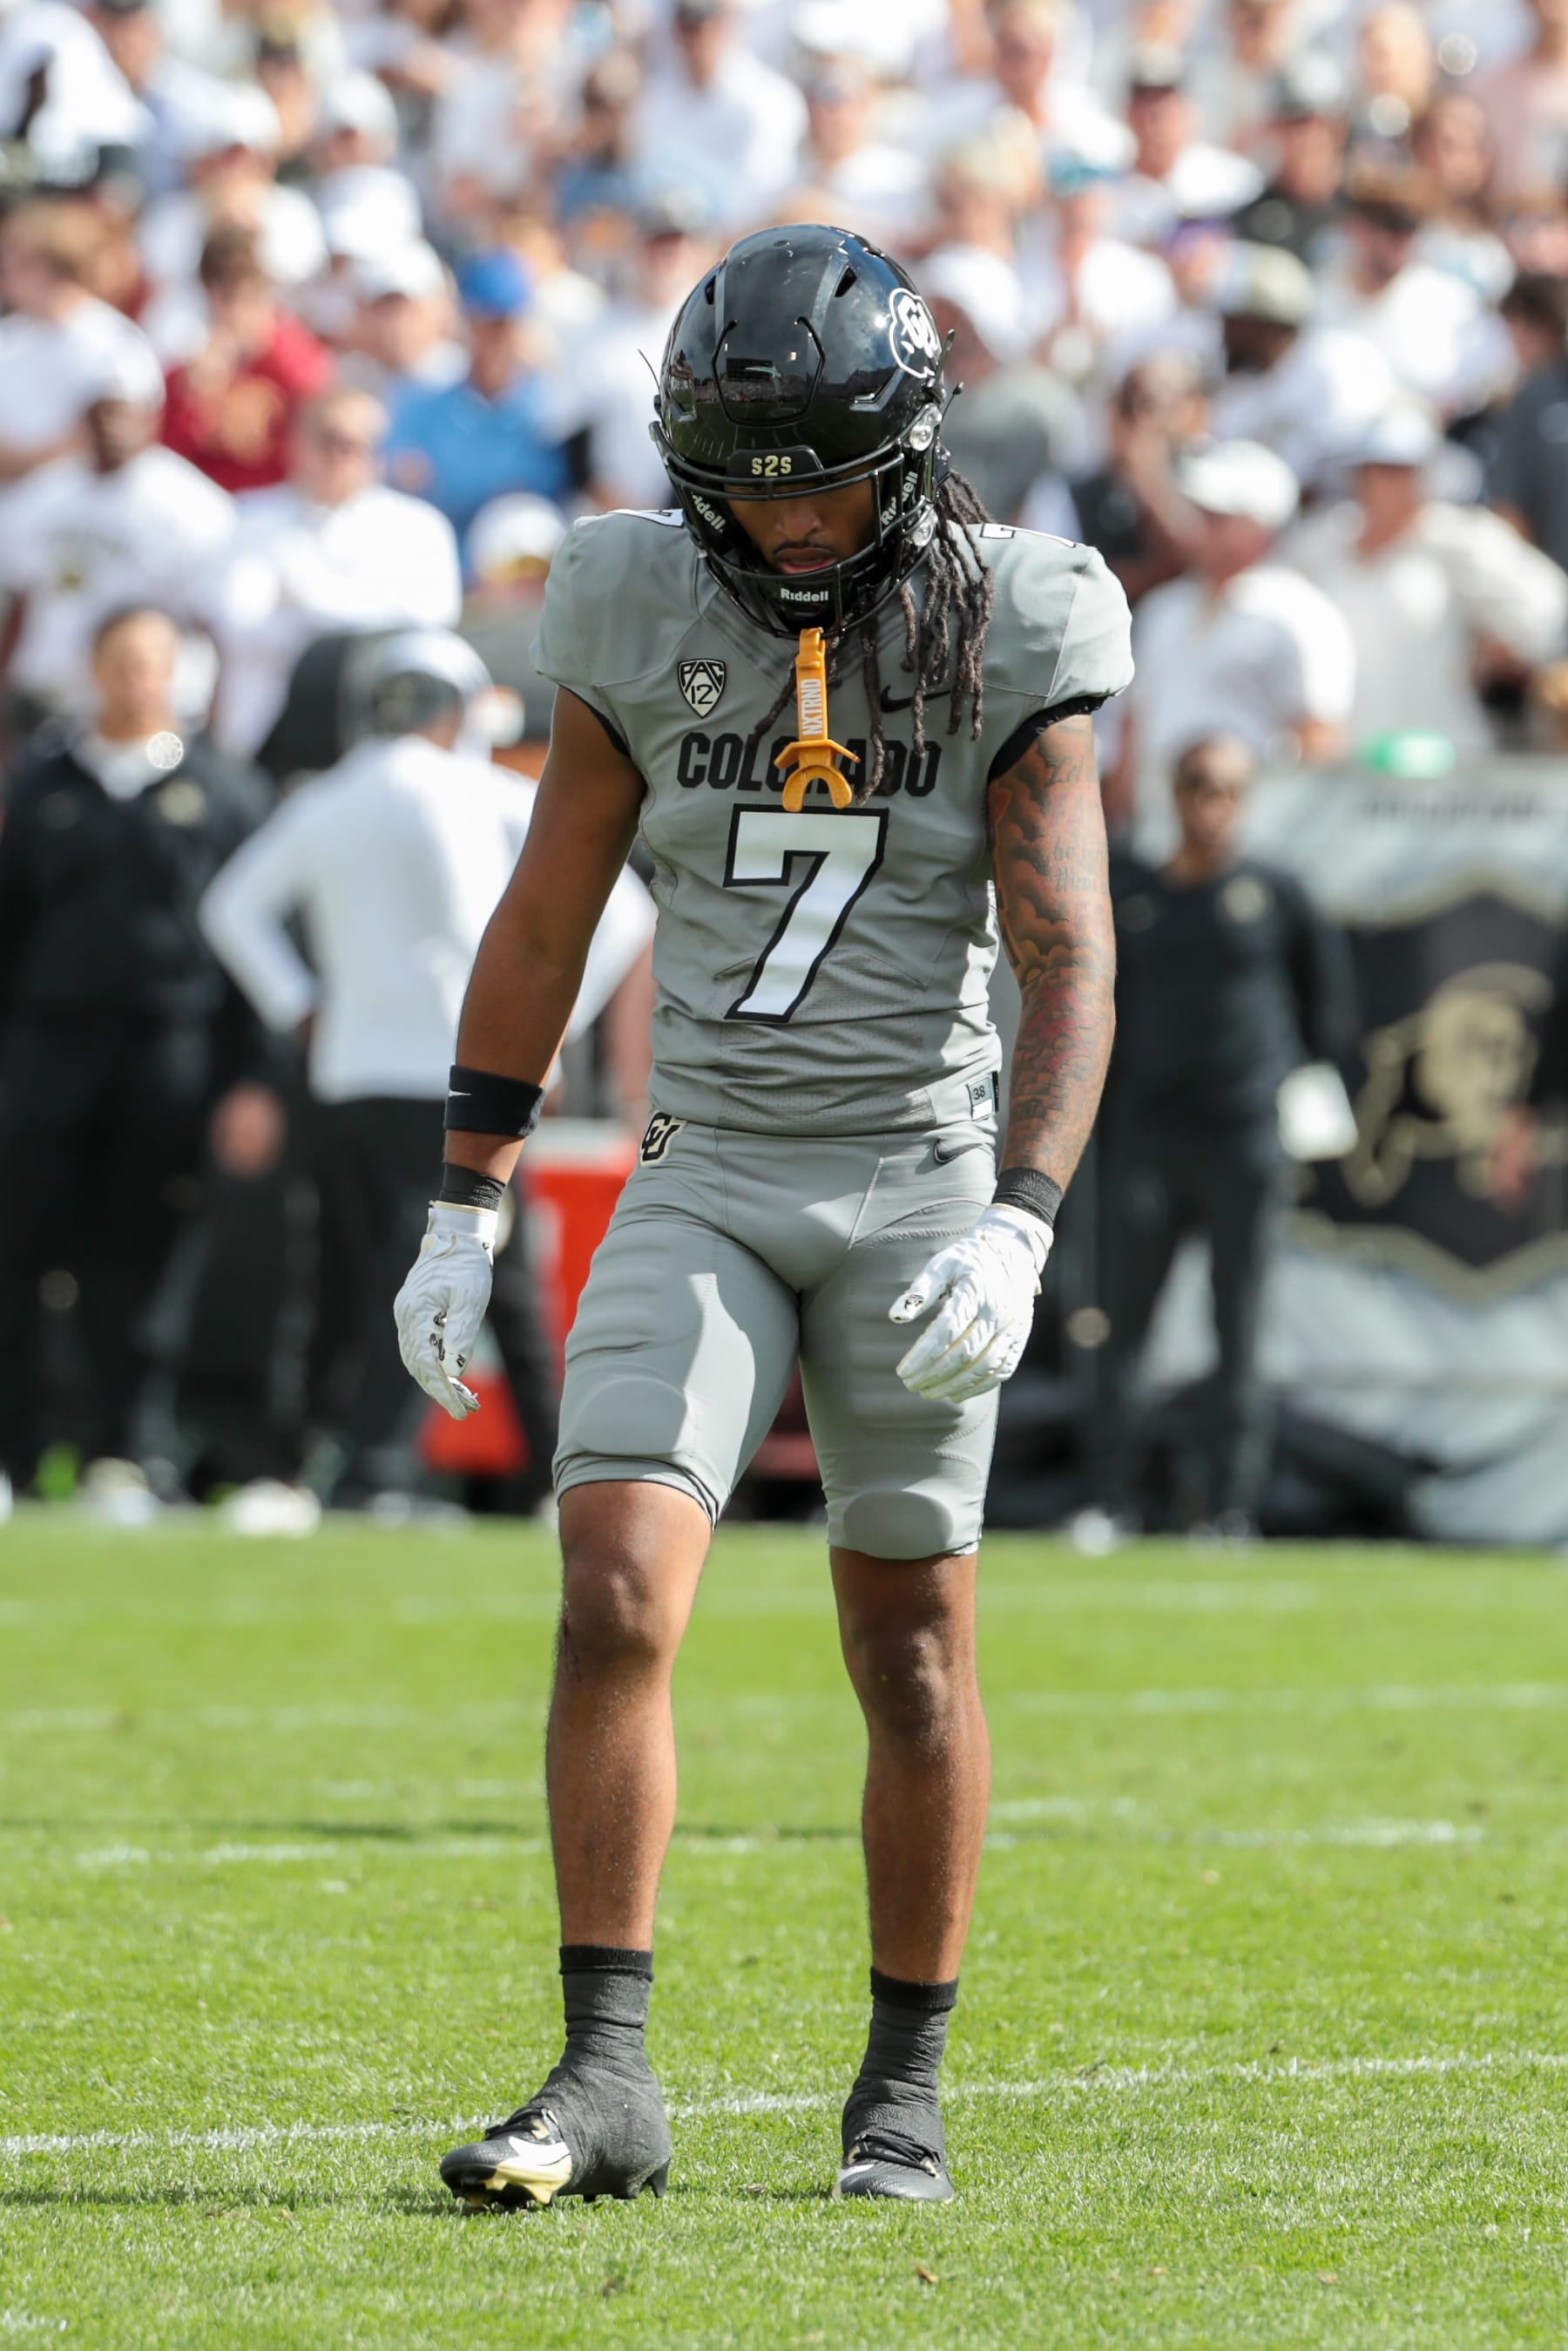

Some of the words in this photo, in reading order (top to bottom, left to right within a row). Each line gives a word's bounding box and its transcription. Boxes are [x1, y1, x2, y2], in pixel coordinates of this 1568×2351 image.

[781, 587, 829, 602] Riddell
[679, 661, 724, 694] PAC
[691, 684, 713, 705] 12
[800, 678, 823, 735] NXTRND
[722, 803, 889, 1024] 7
